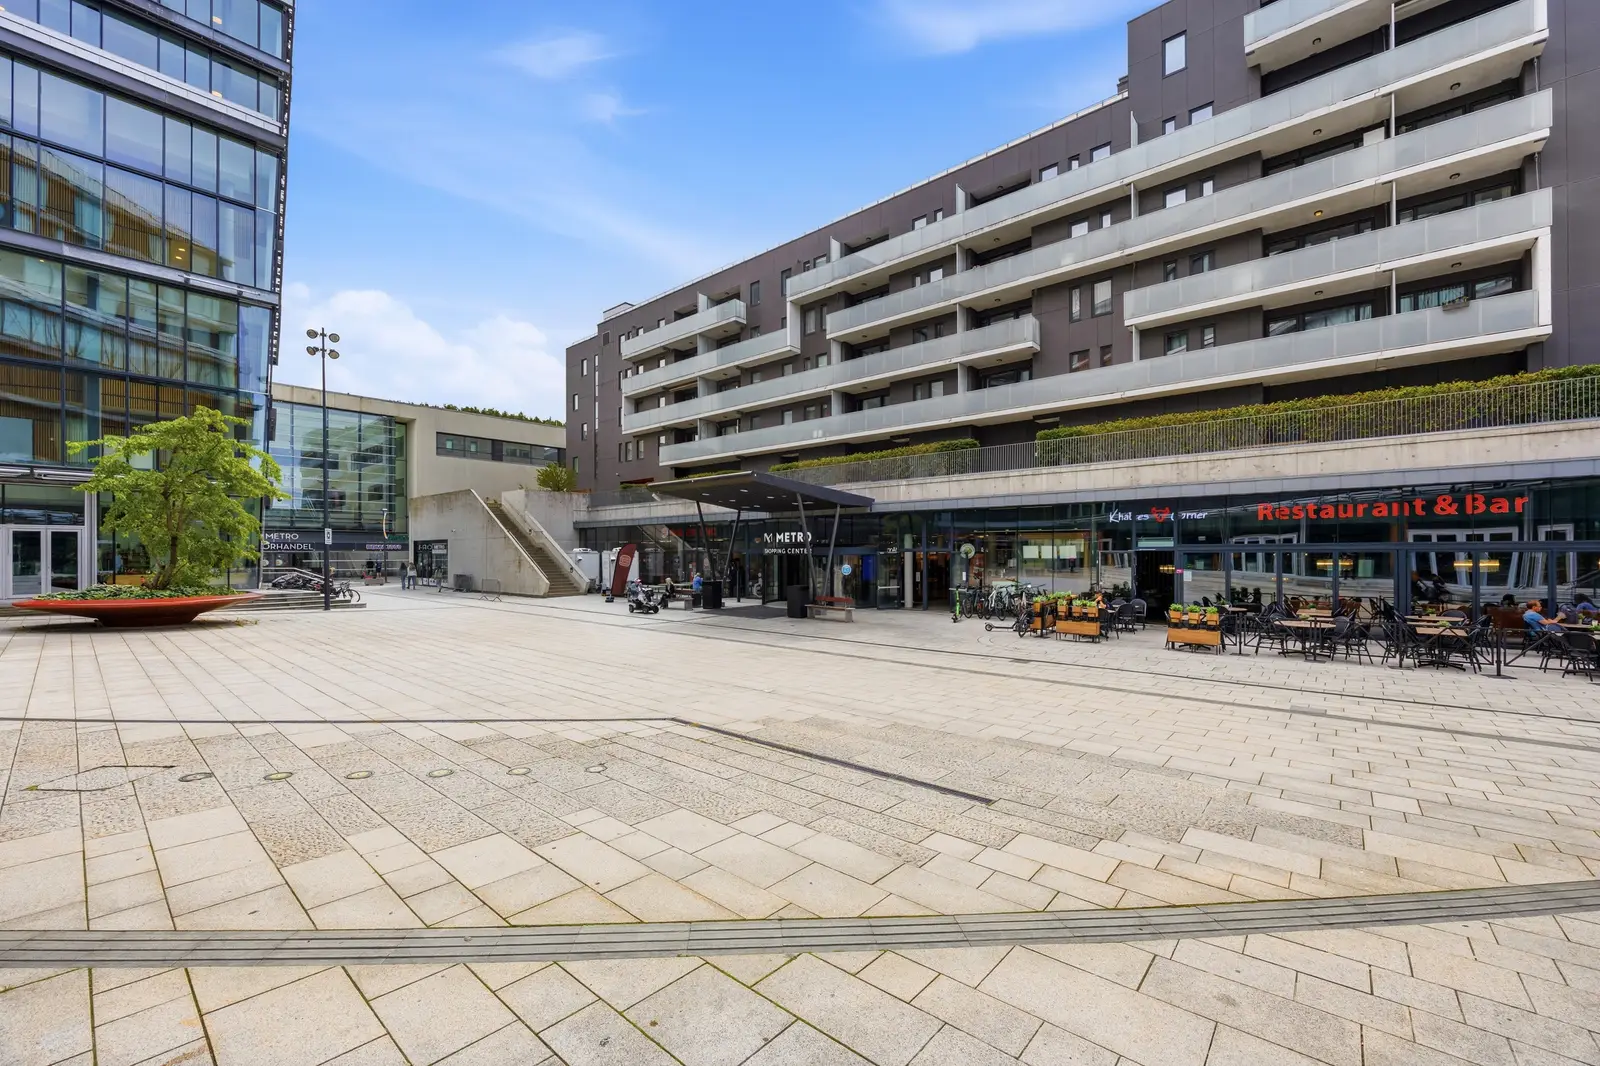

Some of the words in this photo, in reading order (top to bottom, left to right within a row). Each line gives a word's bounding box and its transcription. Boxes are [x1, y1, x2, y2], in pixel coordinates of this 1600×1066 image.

[1257, 497, 1427, 521] Restaurant
[1433, 494, 1459, 515] &
[1465, 493, 1529, 515] Bar
[265, 532, 299, 540] METRO
[776, 532, 812, 542] METRO
